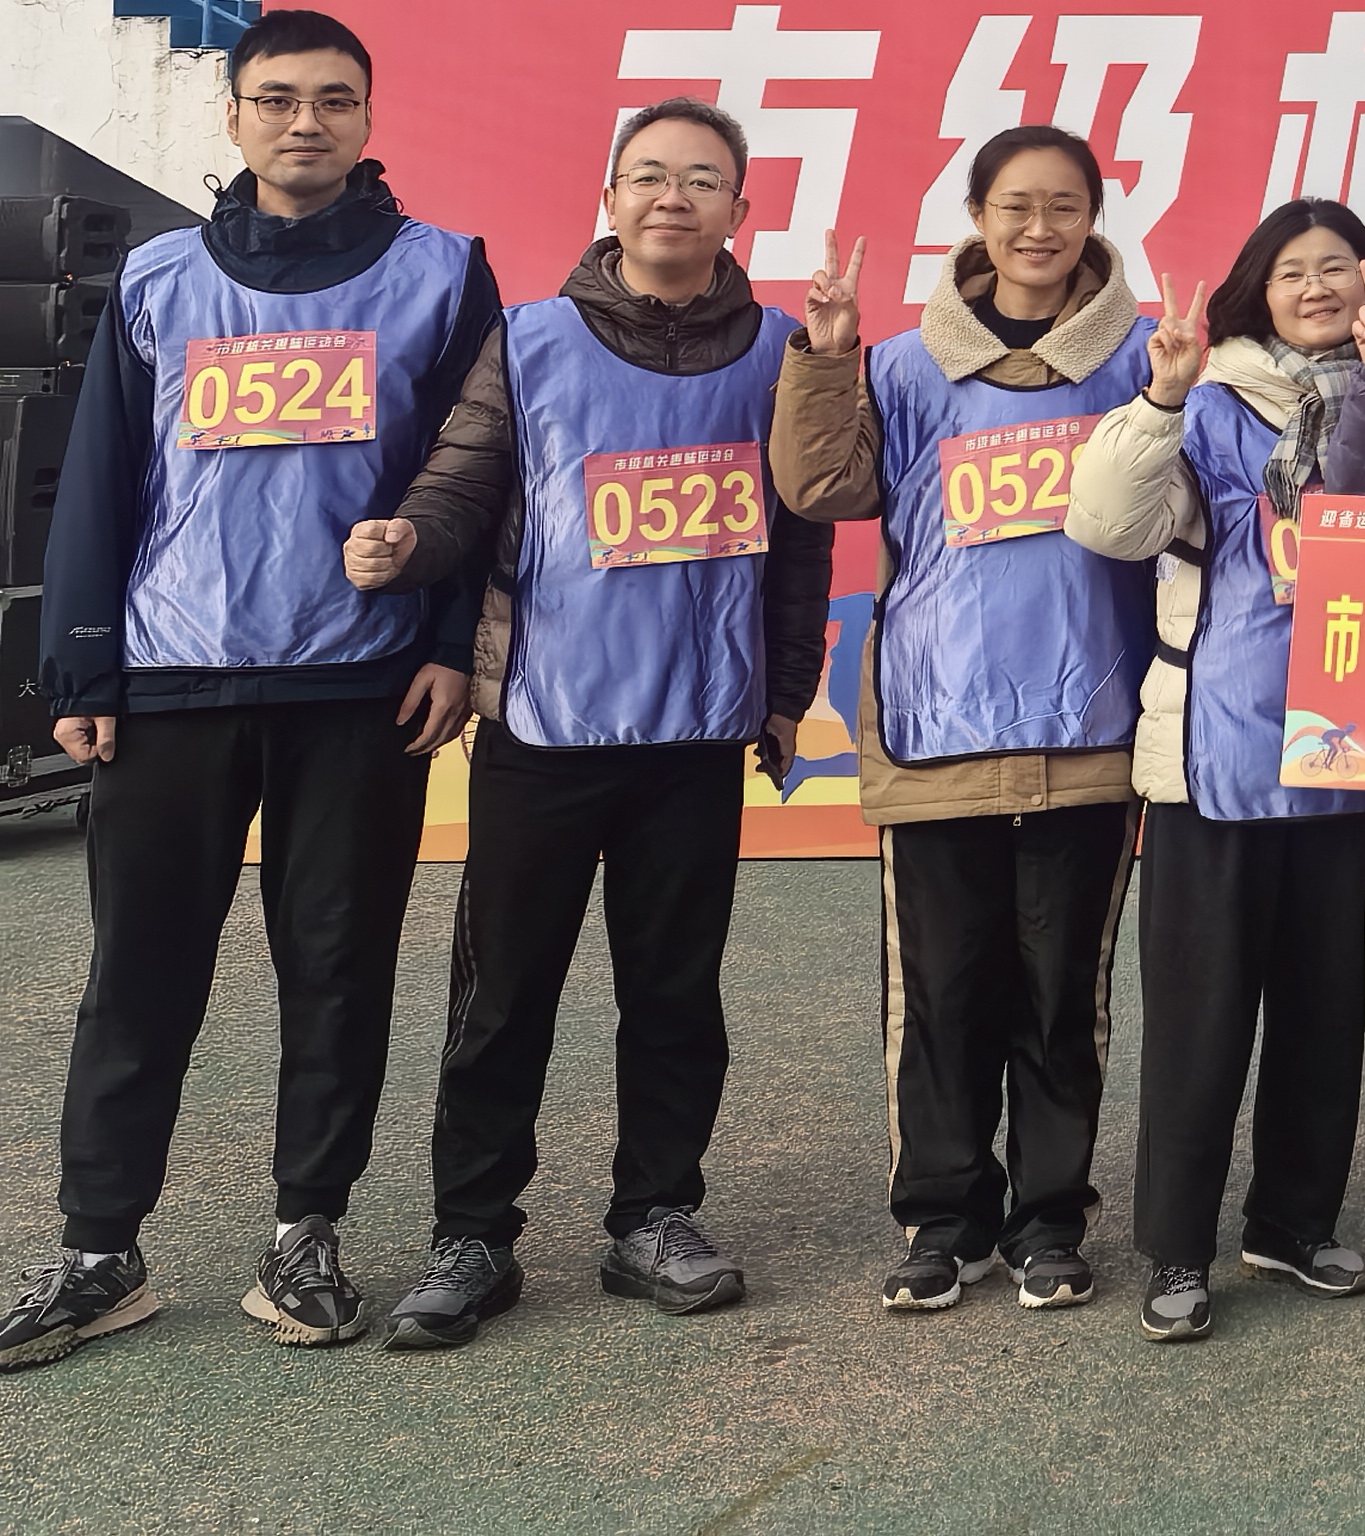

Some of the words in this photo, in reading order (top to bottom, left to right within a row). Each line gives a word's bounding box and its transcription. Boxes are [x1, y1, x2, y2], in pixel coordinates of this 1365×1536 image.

[188, 357, 371, 429] 0524
[593, 470, 760, 546] 0523
[949, 442, 1087, 525] 052
